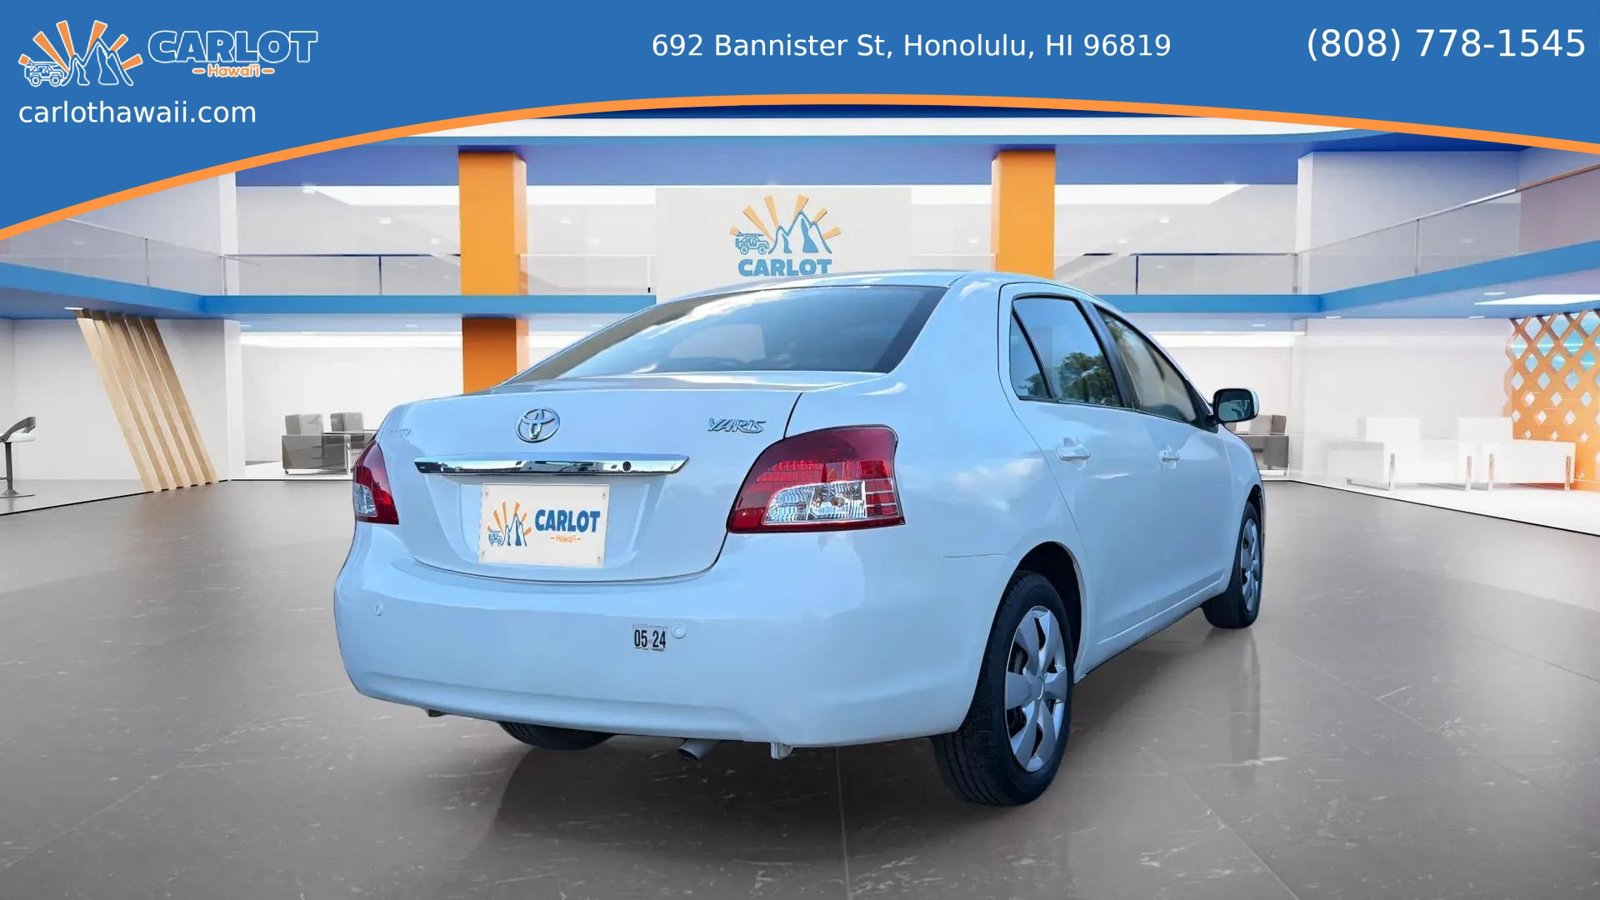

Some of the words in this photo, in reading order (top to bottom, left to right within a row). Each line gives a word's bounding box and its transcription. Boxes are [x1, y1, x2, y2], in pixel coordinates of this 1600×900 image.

[738, 258, 833, 277] CARLOT
[707, 417, 767, 434] YARIS
[534, 509, 601, 533] CARLOT
[634, 629, 648, 648] 05
[652, 630, 666, 649] 24
